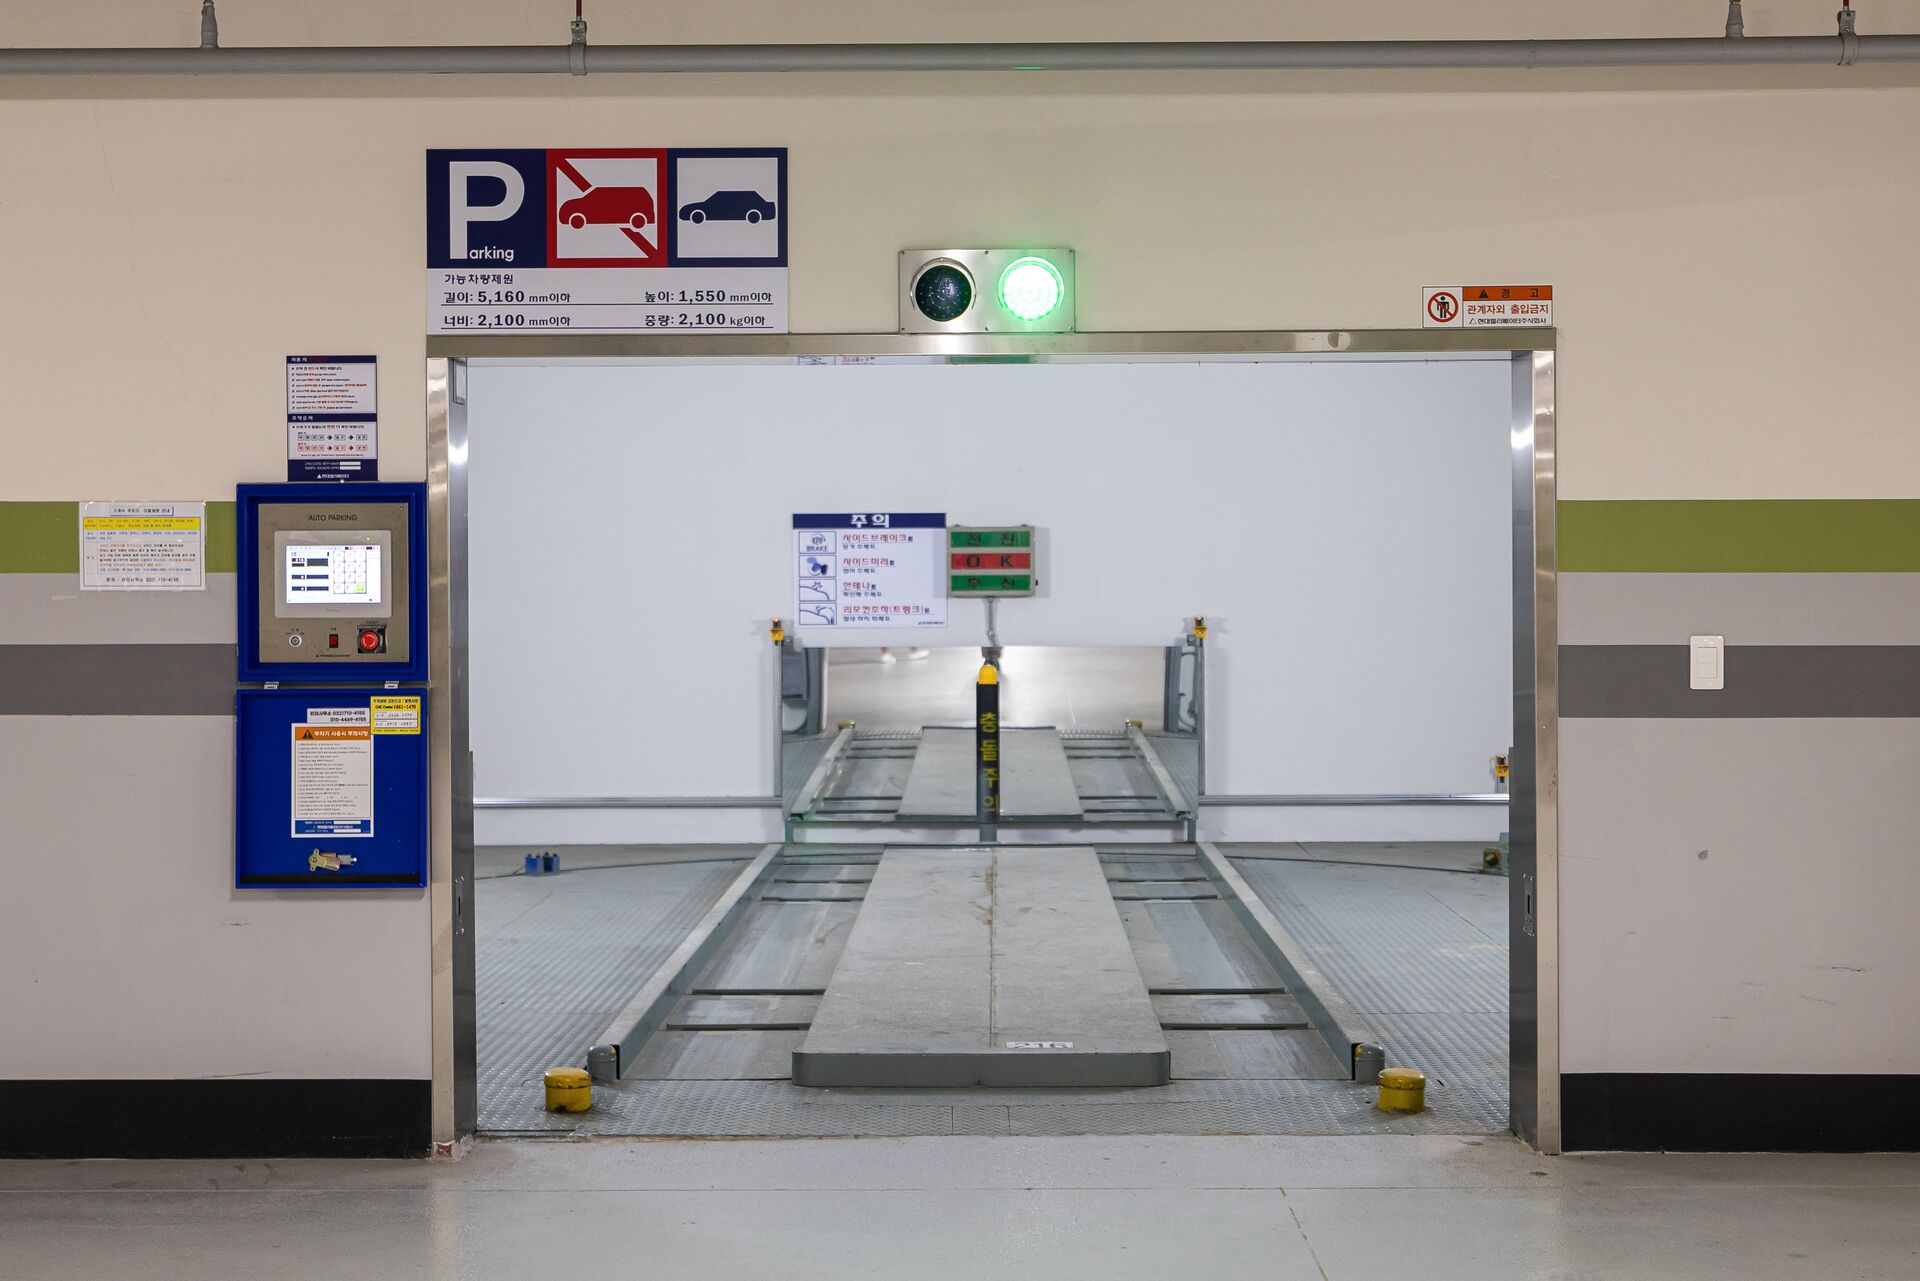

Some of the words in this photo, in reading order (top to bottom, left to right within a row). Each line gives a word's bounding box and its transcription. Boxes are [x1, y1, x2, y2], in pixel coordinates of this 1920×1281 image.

[444, 291, 473, 304] 길이:
[478, 291, 525, 304] 5,160
[529, 293, 571, 303] mm이하
[645, 291, 674, 302] 높이:
[679, 290, 726, 304] 1,550
[730, 292, 772, 302] mm이하
[1467, 304, 1506, 315] 관계자외
[1510, 304, 1549, 314] 출입금지
[444, 315, 473, 327] 너비:
[478, 314, 525, 328] 2,100
[529, 316, 571, 327] mm이하
[645, 314, 674, 327] 중량:
[679, 313, 726, 327] 2,100
[730, 315, 766, 327] kg이하
[851, 514, 889, 529] 주의
